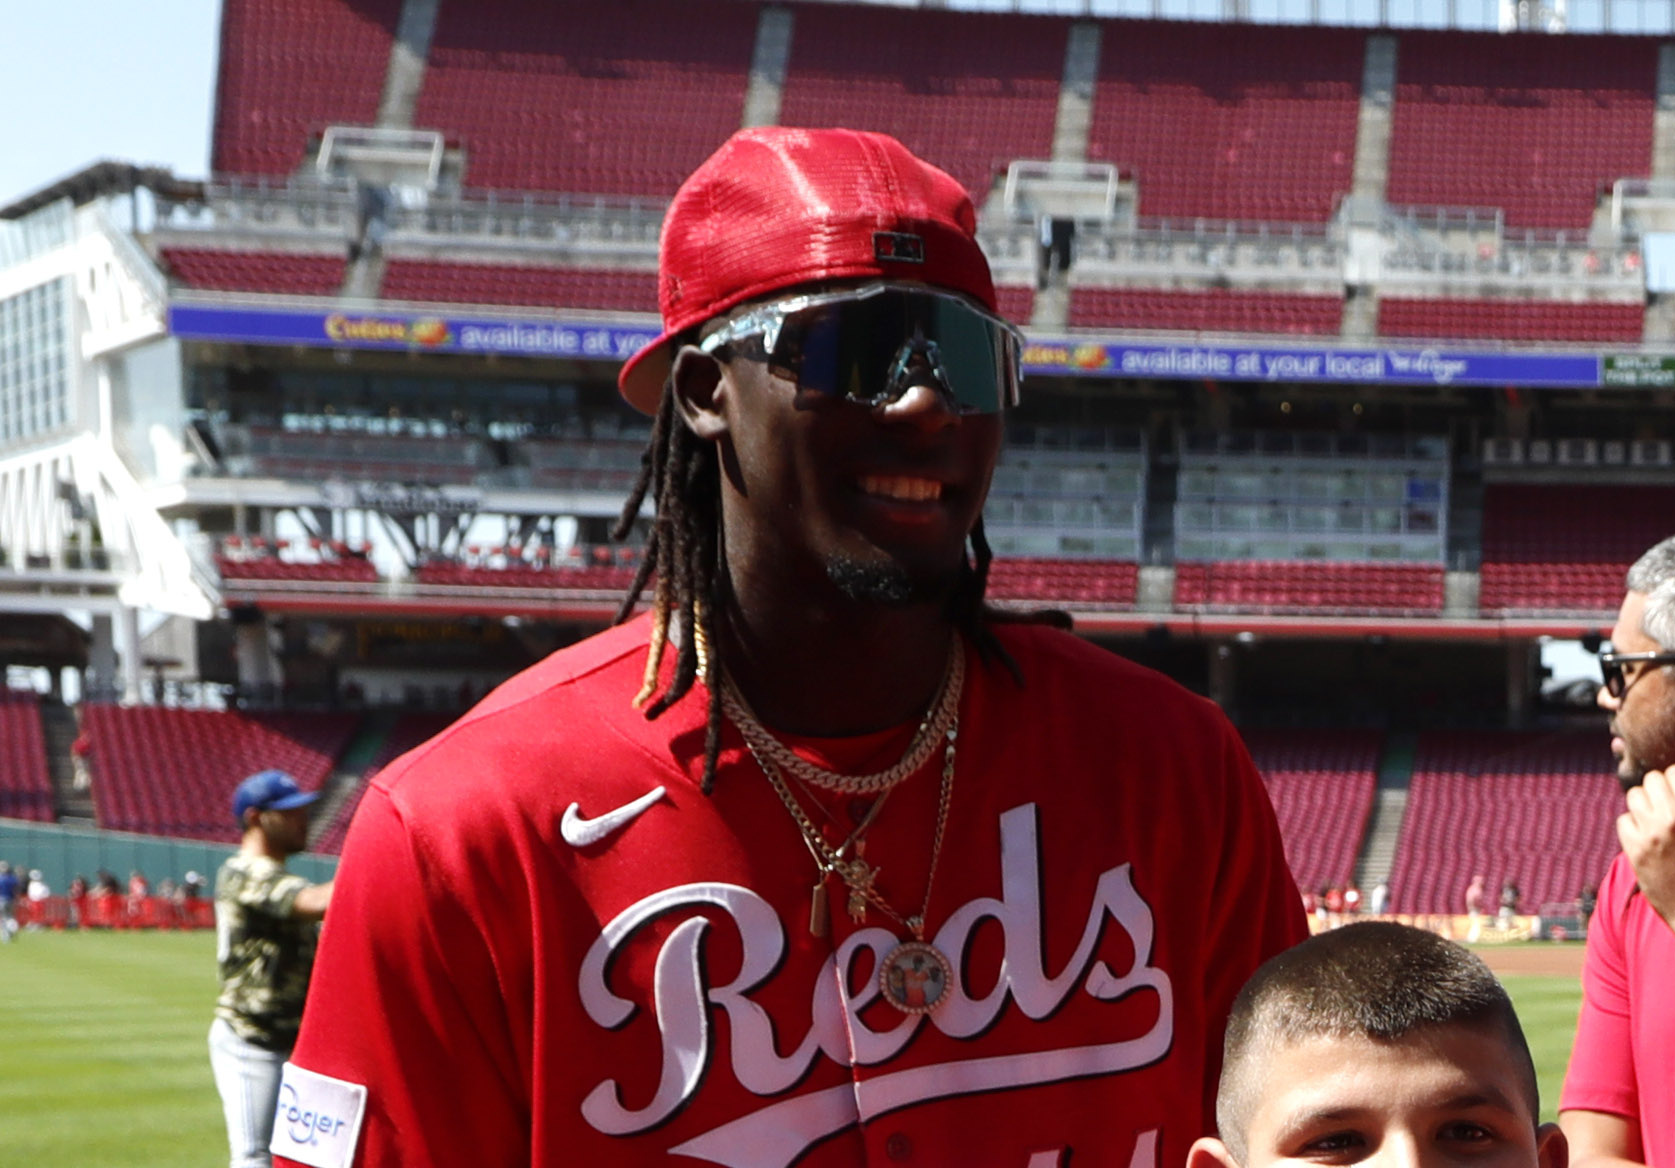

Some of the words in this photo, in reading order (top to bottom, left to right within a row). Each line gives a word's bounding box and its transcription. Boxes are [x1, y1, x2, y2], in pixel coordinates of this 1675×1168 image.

[460, 323, 581, 353] available
[584, 328, 611, 354] at
[1122, 347, 1232, 376] available
[1234, 352, 1260, 376] at
[1264, 353, 1322, 381] your
[1325, 350, 1385, 379] local
[577, 801, 1177, 1137] Reds
